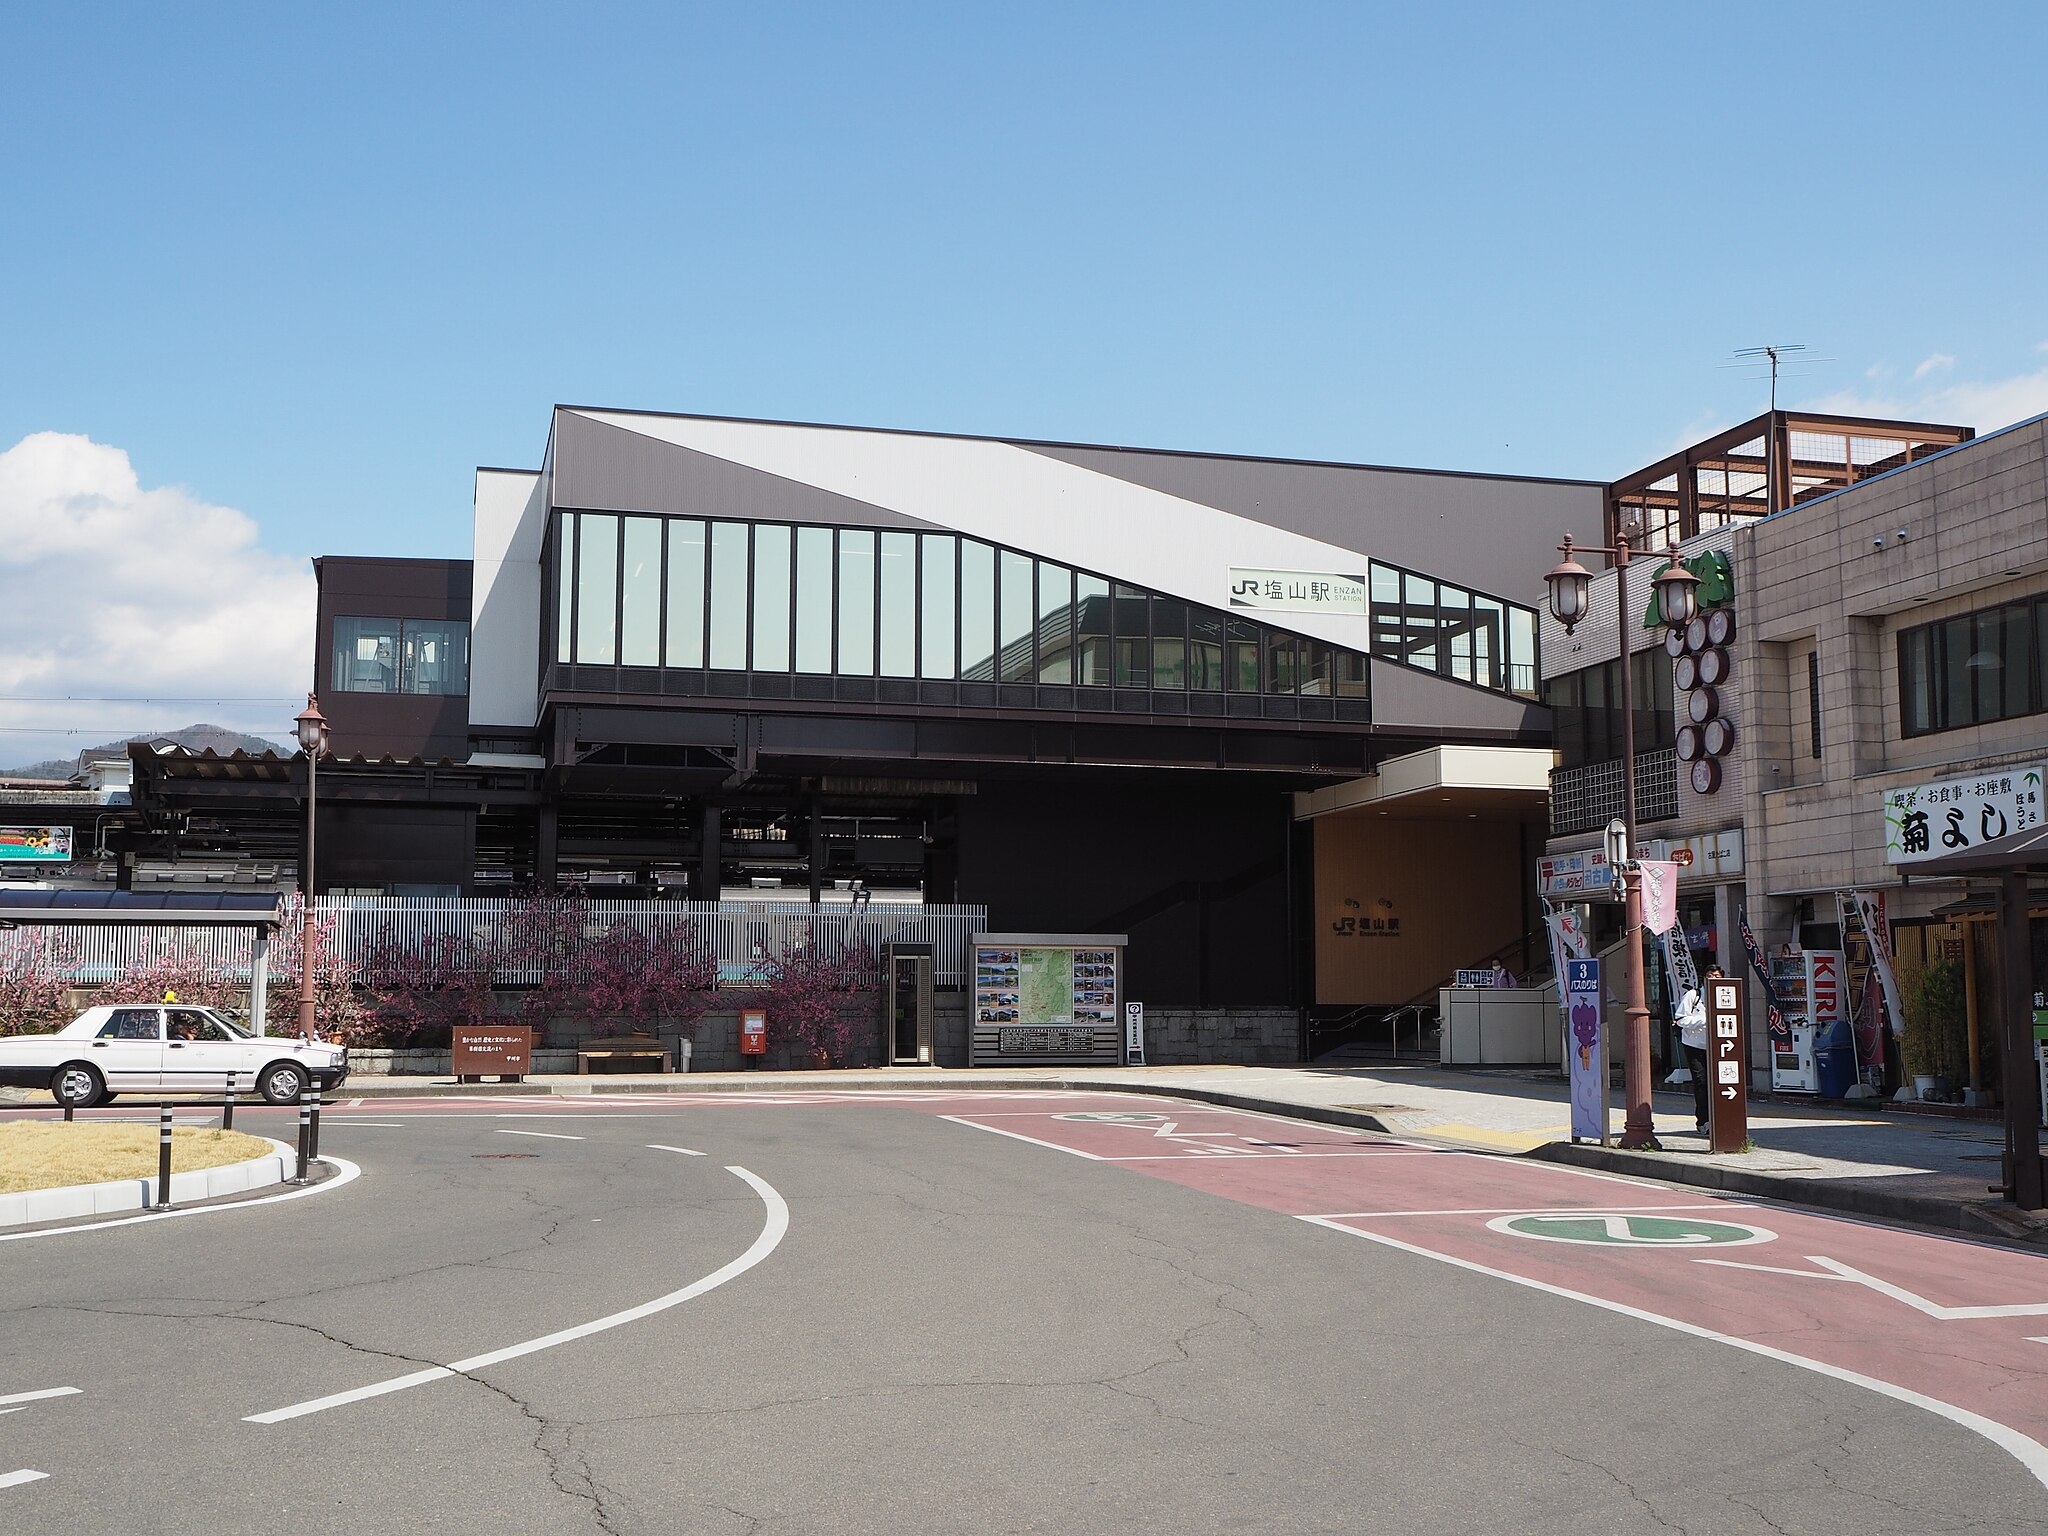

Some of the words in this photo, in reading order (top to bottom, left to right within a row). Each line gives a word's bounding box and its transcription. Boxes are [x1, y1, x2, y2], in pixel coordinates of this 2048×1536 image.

[1232, 579, 1259, 596] JR
[1264, 580, 1330, 602] 塩山駅
[1333, 585, 1362, 596] ENZAN
[1333, 594, 1362, 602] STATION
[1894, 777, 2012, 809] 喫茶・お食事・お座敷
[2015, 793, 2026, 830] ほうと
[2027, 791, 2037, 823] 馬さ
[1901, 802, 2008, 854] 菊よし
[1332, 917, 1355, 931] JR
[1579, 963, 1588, 979] 3
[1570, 979, 1598, 990] バスのりば
[1813, 956, 1838, 1021] KIRI
[1535, 1214, 1712, 1244] 2
